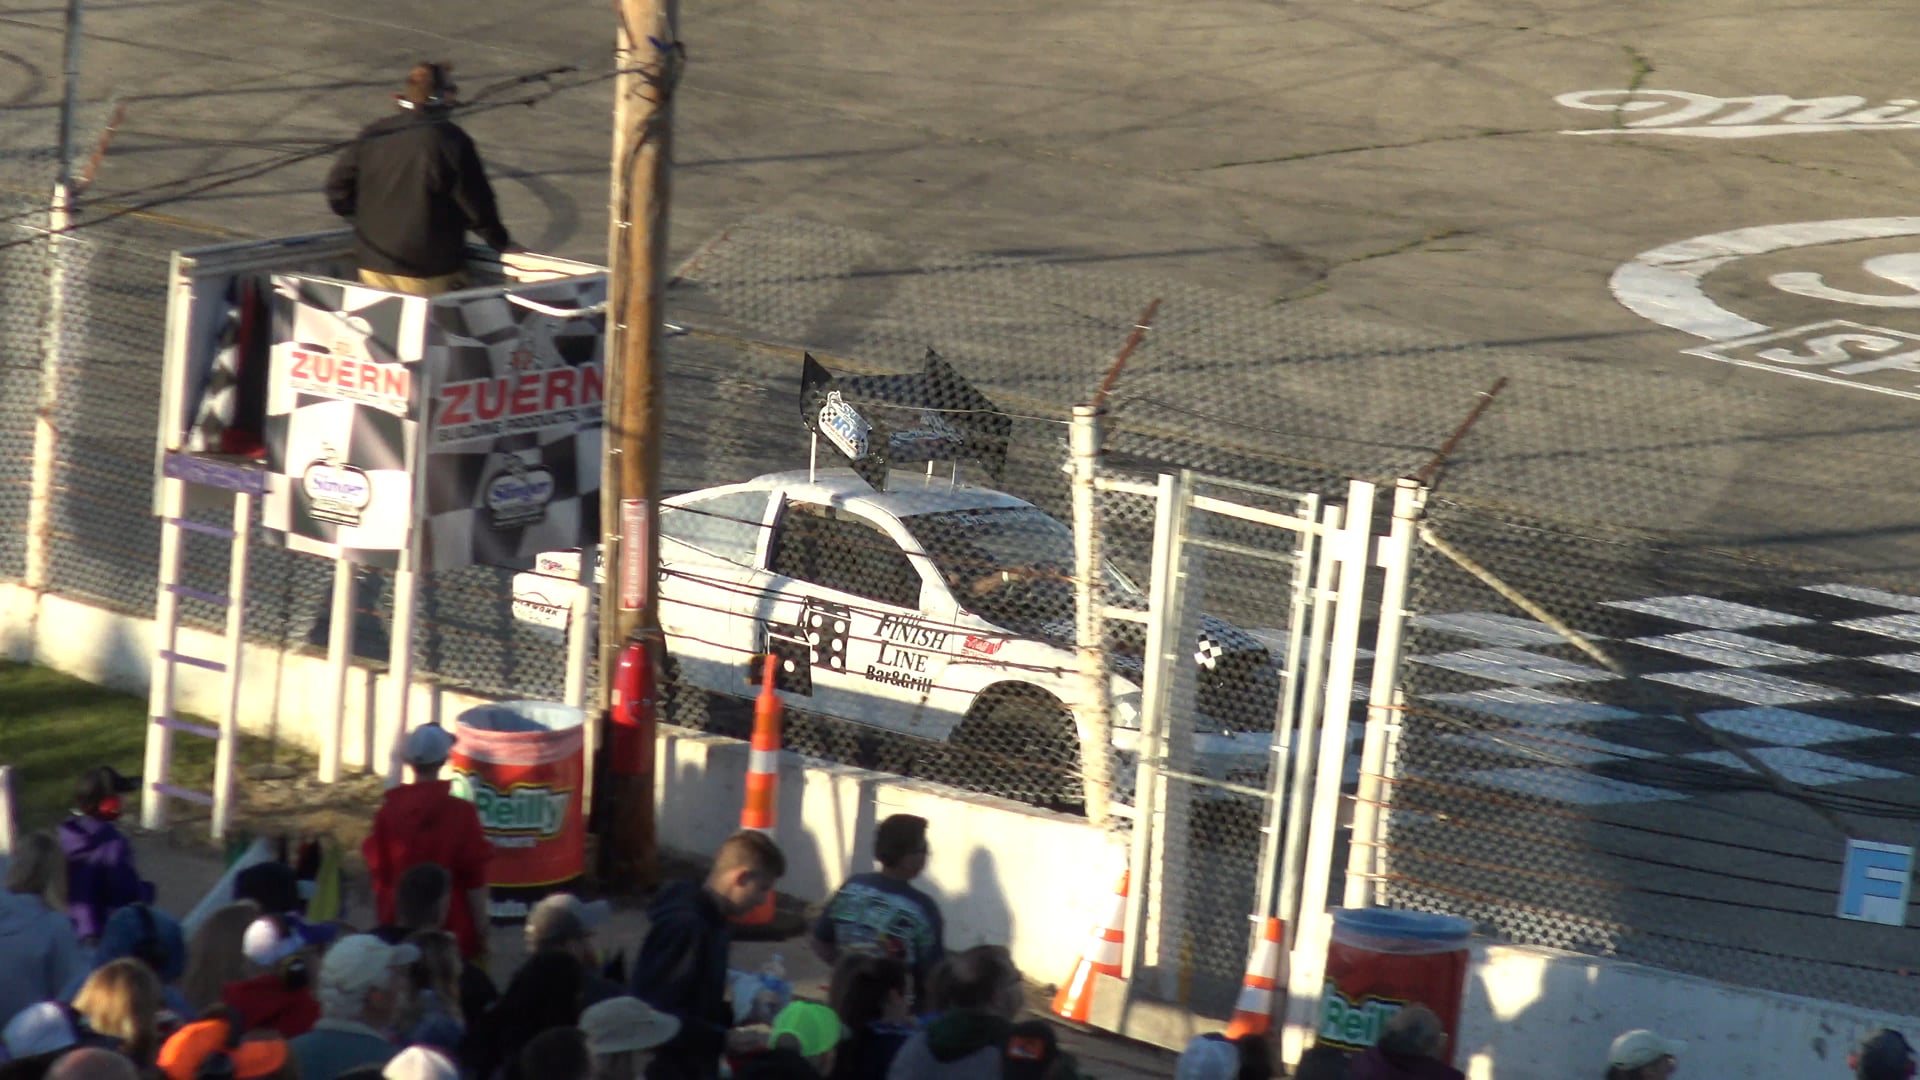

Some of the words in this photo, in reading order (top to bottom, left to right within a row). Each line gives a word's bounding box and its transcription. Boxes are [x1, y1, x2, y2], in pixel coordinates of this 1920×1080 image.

[290, 351, 411, 398] ZUERN
[440, 366, 603, 426] ZUERN
[873, 613, 950, 651] FINISH
[876, 640, 930, 673] LINE
[866, 664, 933, 694] Bar&Grill
[1845, 847, 1910, 916] F
